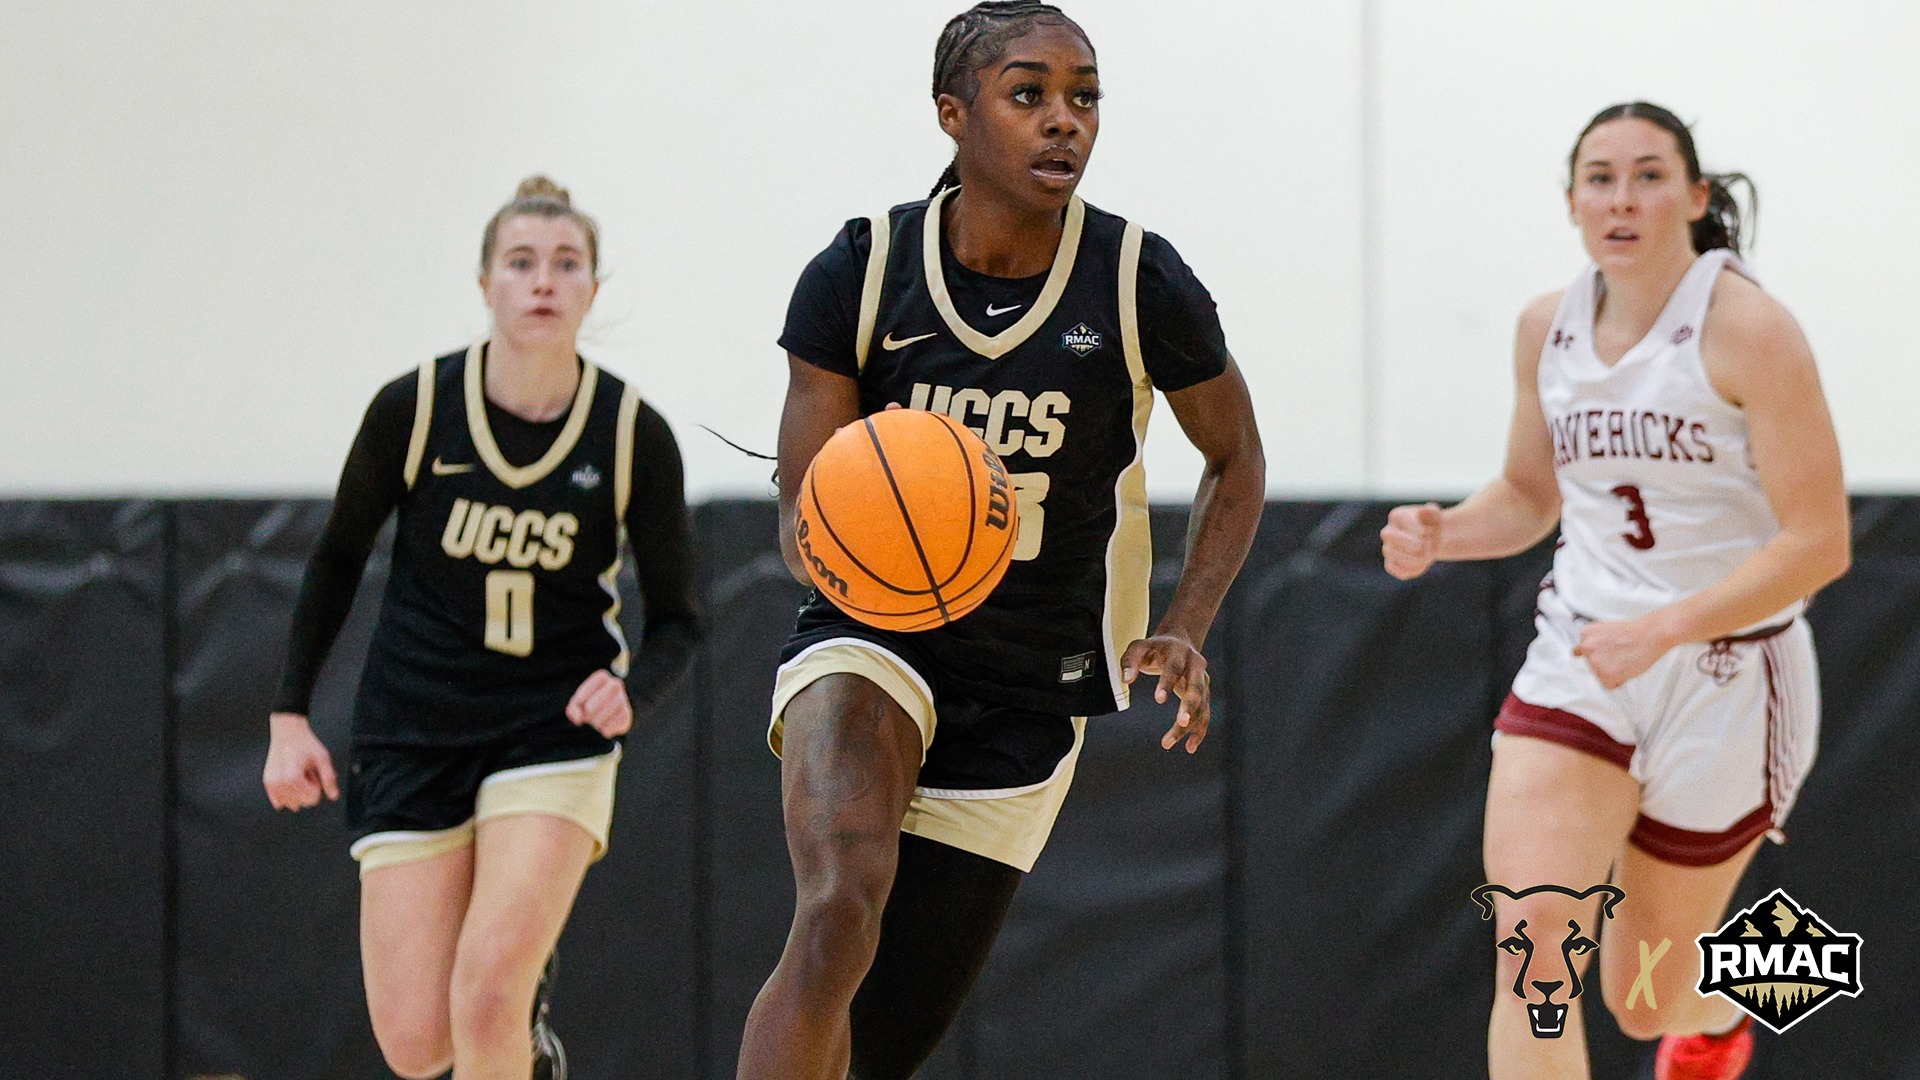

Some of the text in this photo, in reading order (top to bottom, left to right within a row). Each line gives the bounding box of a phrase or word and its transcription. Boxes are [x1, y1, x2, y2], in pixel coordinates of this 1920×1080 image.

[1065, 335, 1100, 346] RMAC
[1550, 410, 1714, 467] AVERICKS
[440, 497, 580, 571] UCCS
[1610, 485, 1655, 550] 3
[484, 569, 535, 658] 0
